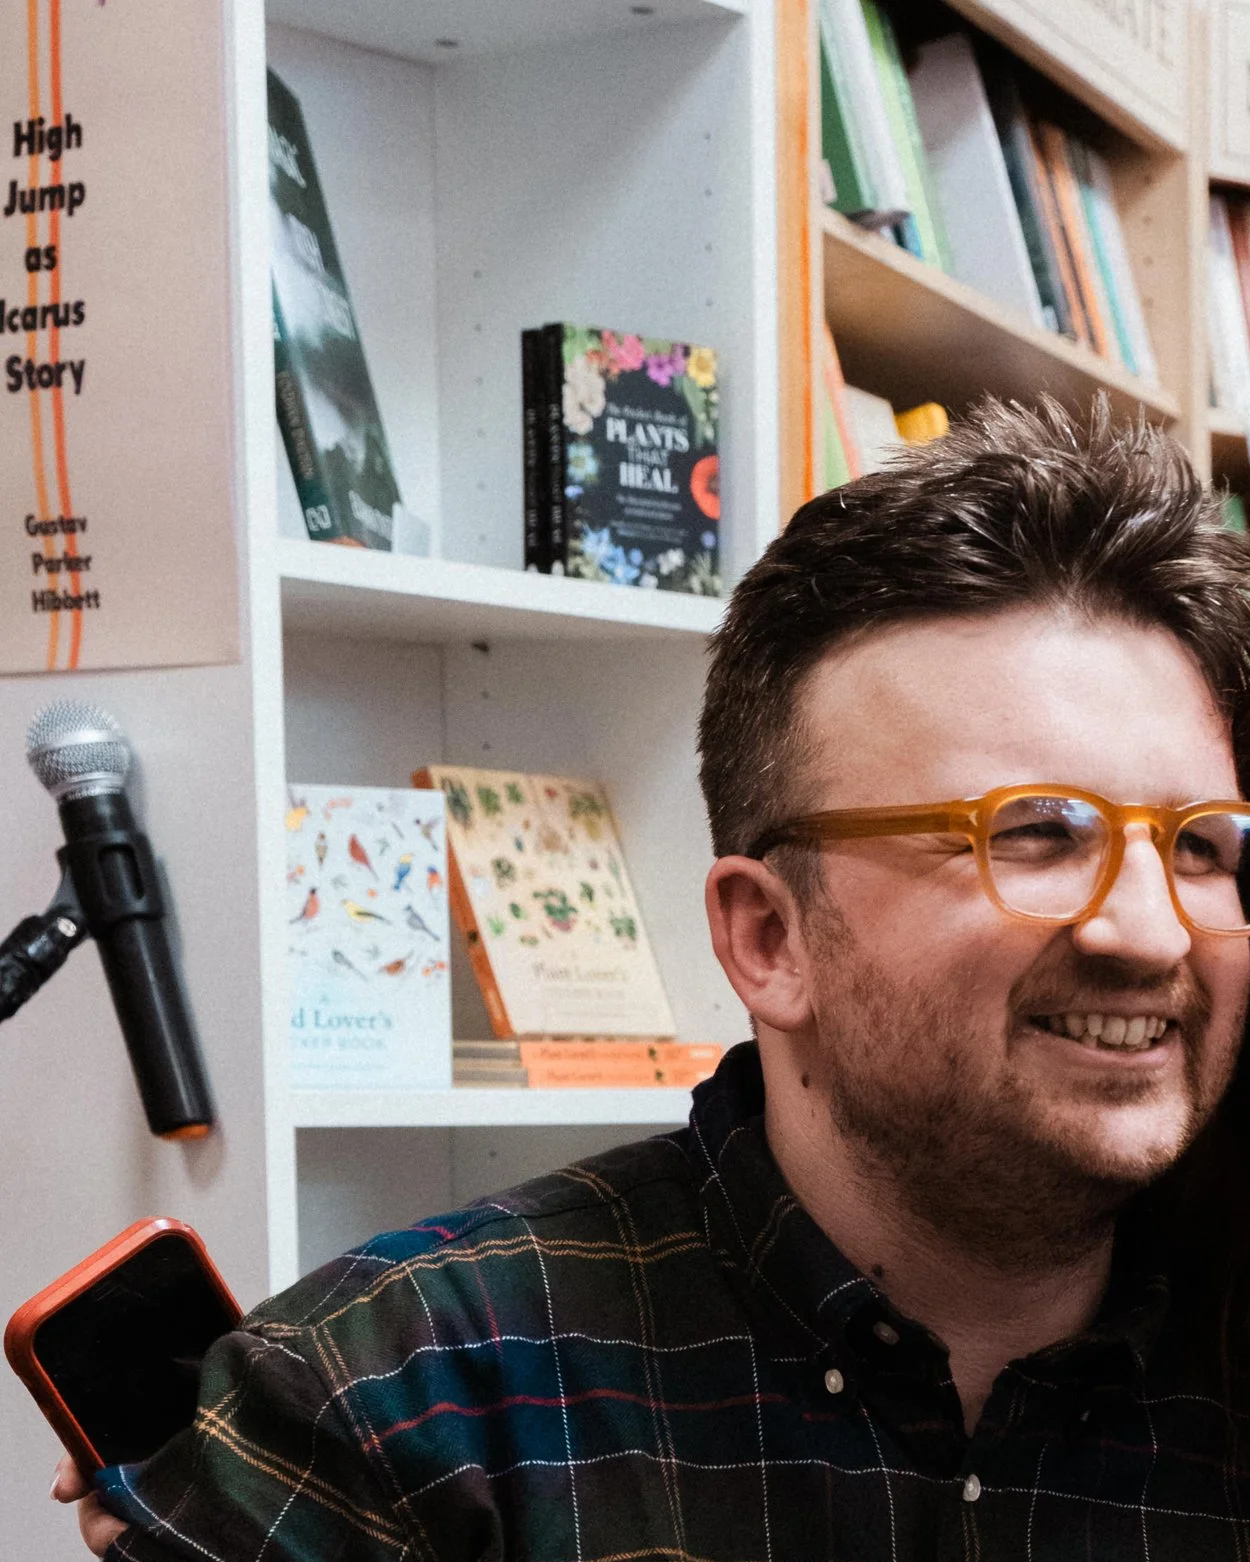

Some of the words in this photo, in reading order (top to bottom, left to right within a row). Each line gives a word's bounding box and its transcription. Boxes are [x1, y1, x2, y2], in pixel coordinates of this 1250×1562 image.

[12, 113, 83, 162] High
[4, 179, 86, 217] Jump
[24, 245, 58, 272] as
[0, 299, 86, 334] Icarus
[6, 355, 85, 395] Story
[606, 416, 690, 453] PLANTS
[619, 461, 679, 494] HEAL
[24, 513, 87, 537] Gustav
[31, 551, 92, 574] Parker
[31, 588, 101, 612] Hibbett
